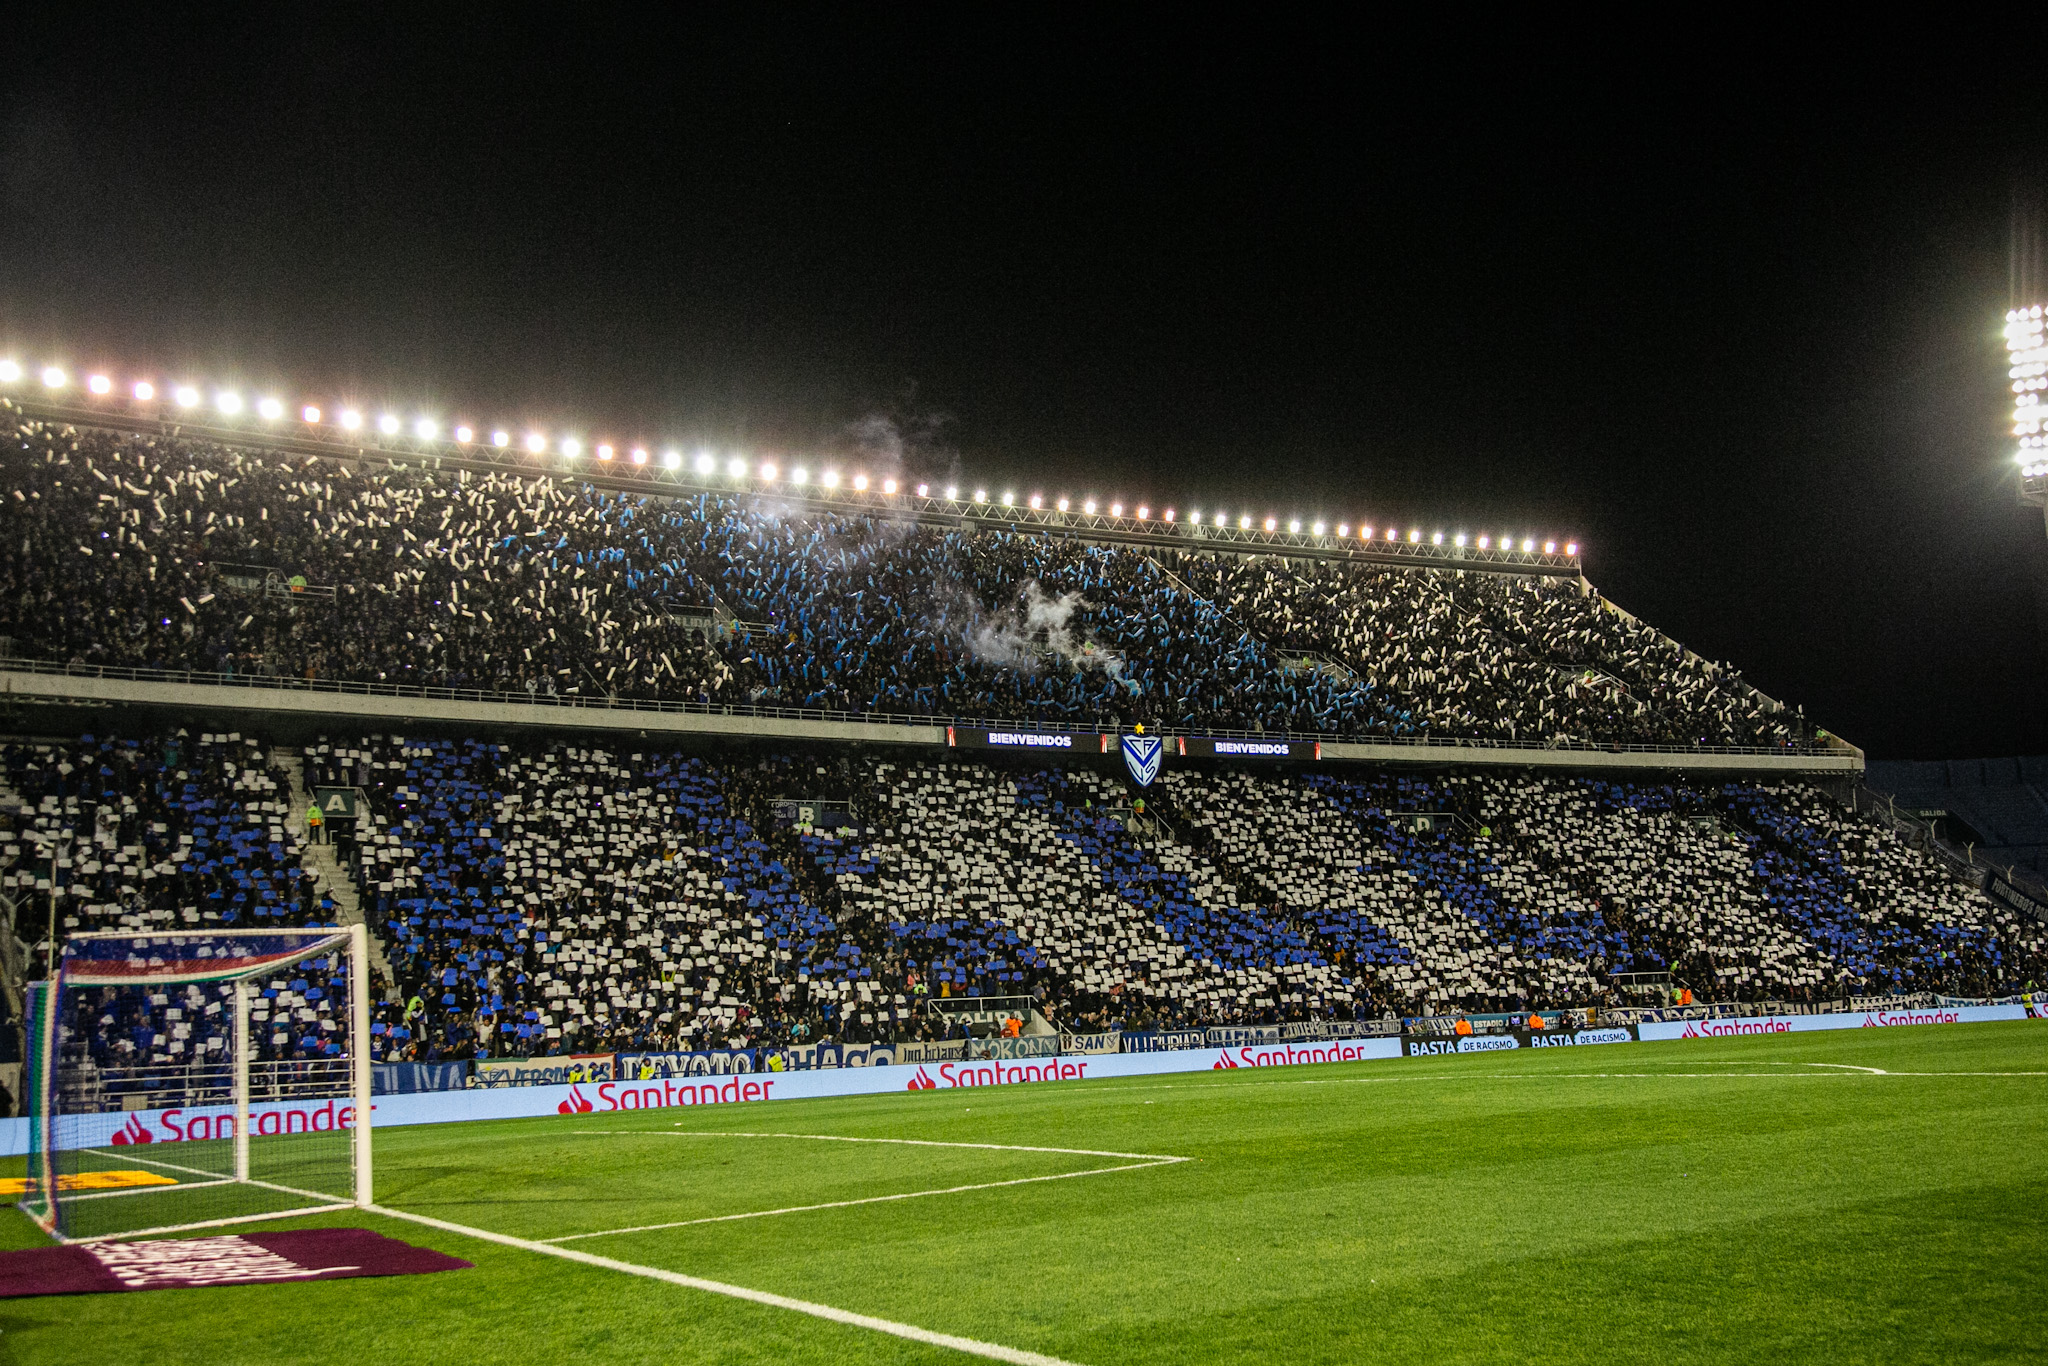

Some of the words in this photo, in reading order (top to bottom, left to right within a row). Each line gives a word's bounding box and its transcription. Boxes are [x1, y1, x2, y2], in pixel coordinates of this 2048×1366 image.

[988, 732, 1072, 748] BIENVENIDOS
[1214, 741, 1289, 756] BIENVENIDOS
[325, 794, 347, 812] A
[799, 806, 815, 822] B
[1919, 809, 1947, 817] SALIDA
[1473, 1019, 1504, 1028] ESTADIO
[1878, 1009, 1959, 1027] Santander
[1700, 1018, 1792, 1037] Santander
[971, 1038, 1044, 1060] MORON
[1074, 1035, 1105, 1050] SAN
[1409, 1040, 1456, 1057] BASTA
[1463, 1043, 1475, 1052] DE
[1476, 1040, 1513, 1051] RACISMO
[1531, 1034, 1574, 1049] BASTA
[1580, 1035, 1591, 1044] DE
[1592, 1032, 1626, 1043] RACISMO
[1241, 1042, 1365, 1067] Santander
[939, 1058, 1088, 1088] Santander
[598, 1076, 774, 1113] Santander
